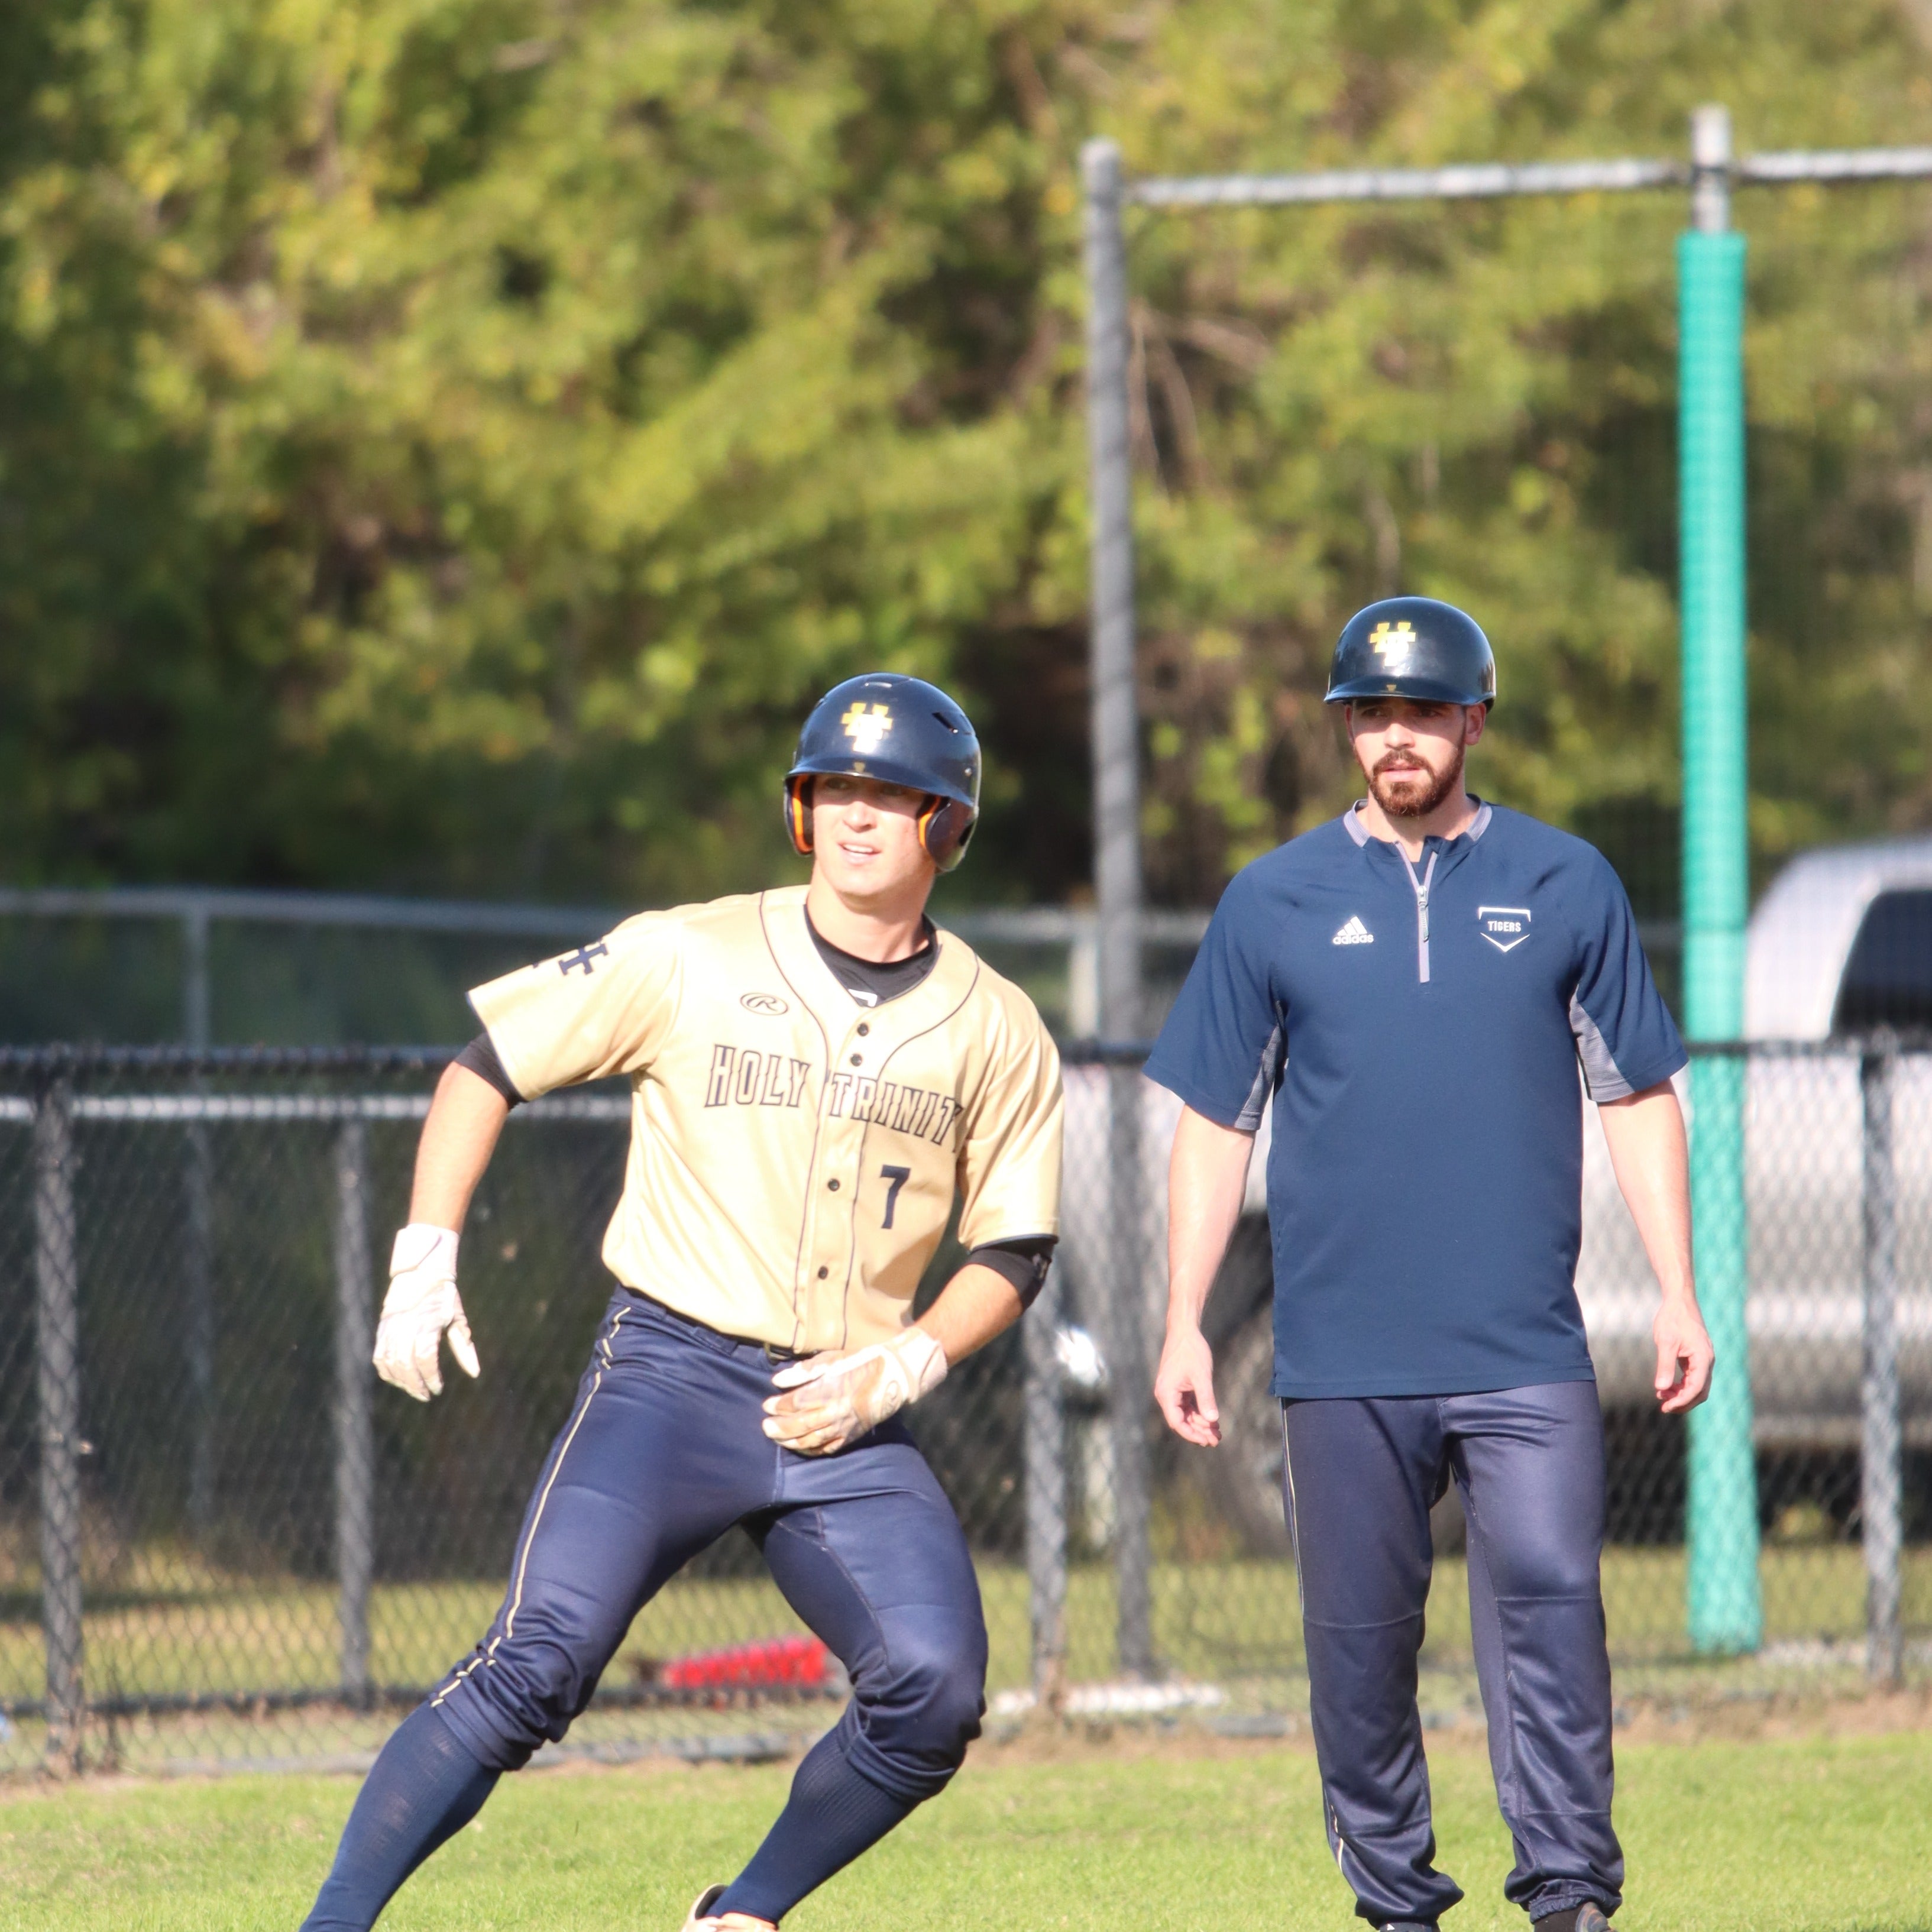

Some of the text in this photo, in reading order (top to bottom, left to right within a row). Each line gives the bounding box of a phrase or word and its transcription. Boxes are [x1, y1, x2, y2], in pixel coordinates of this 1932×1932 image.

[1332, 933, 1374, 945] adidas
[1487, 920, 1522, 933] TIGERS
[703, 1043, 964, 1153] HOLY TRINIT
[879, 1163, 911, 1229] 7
